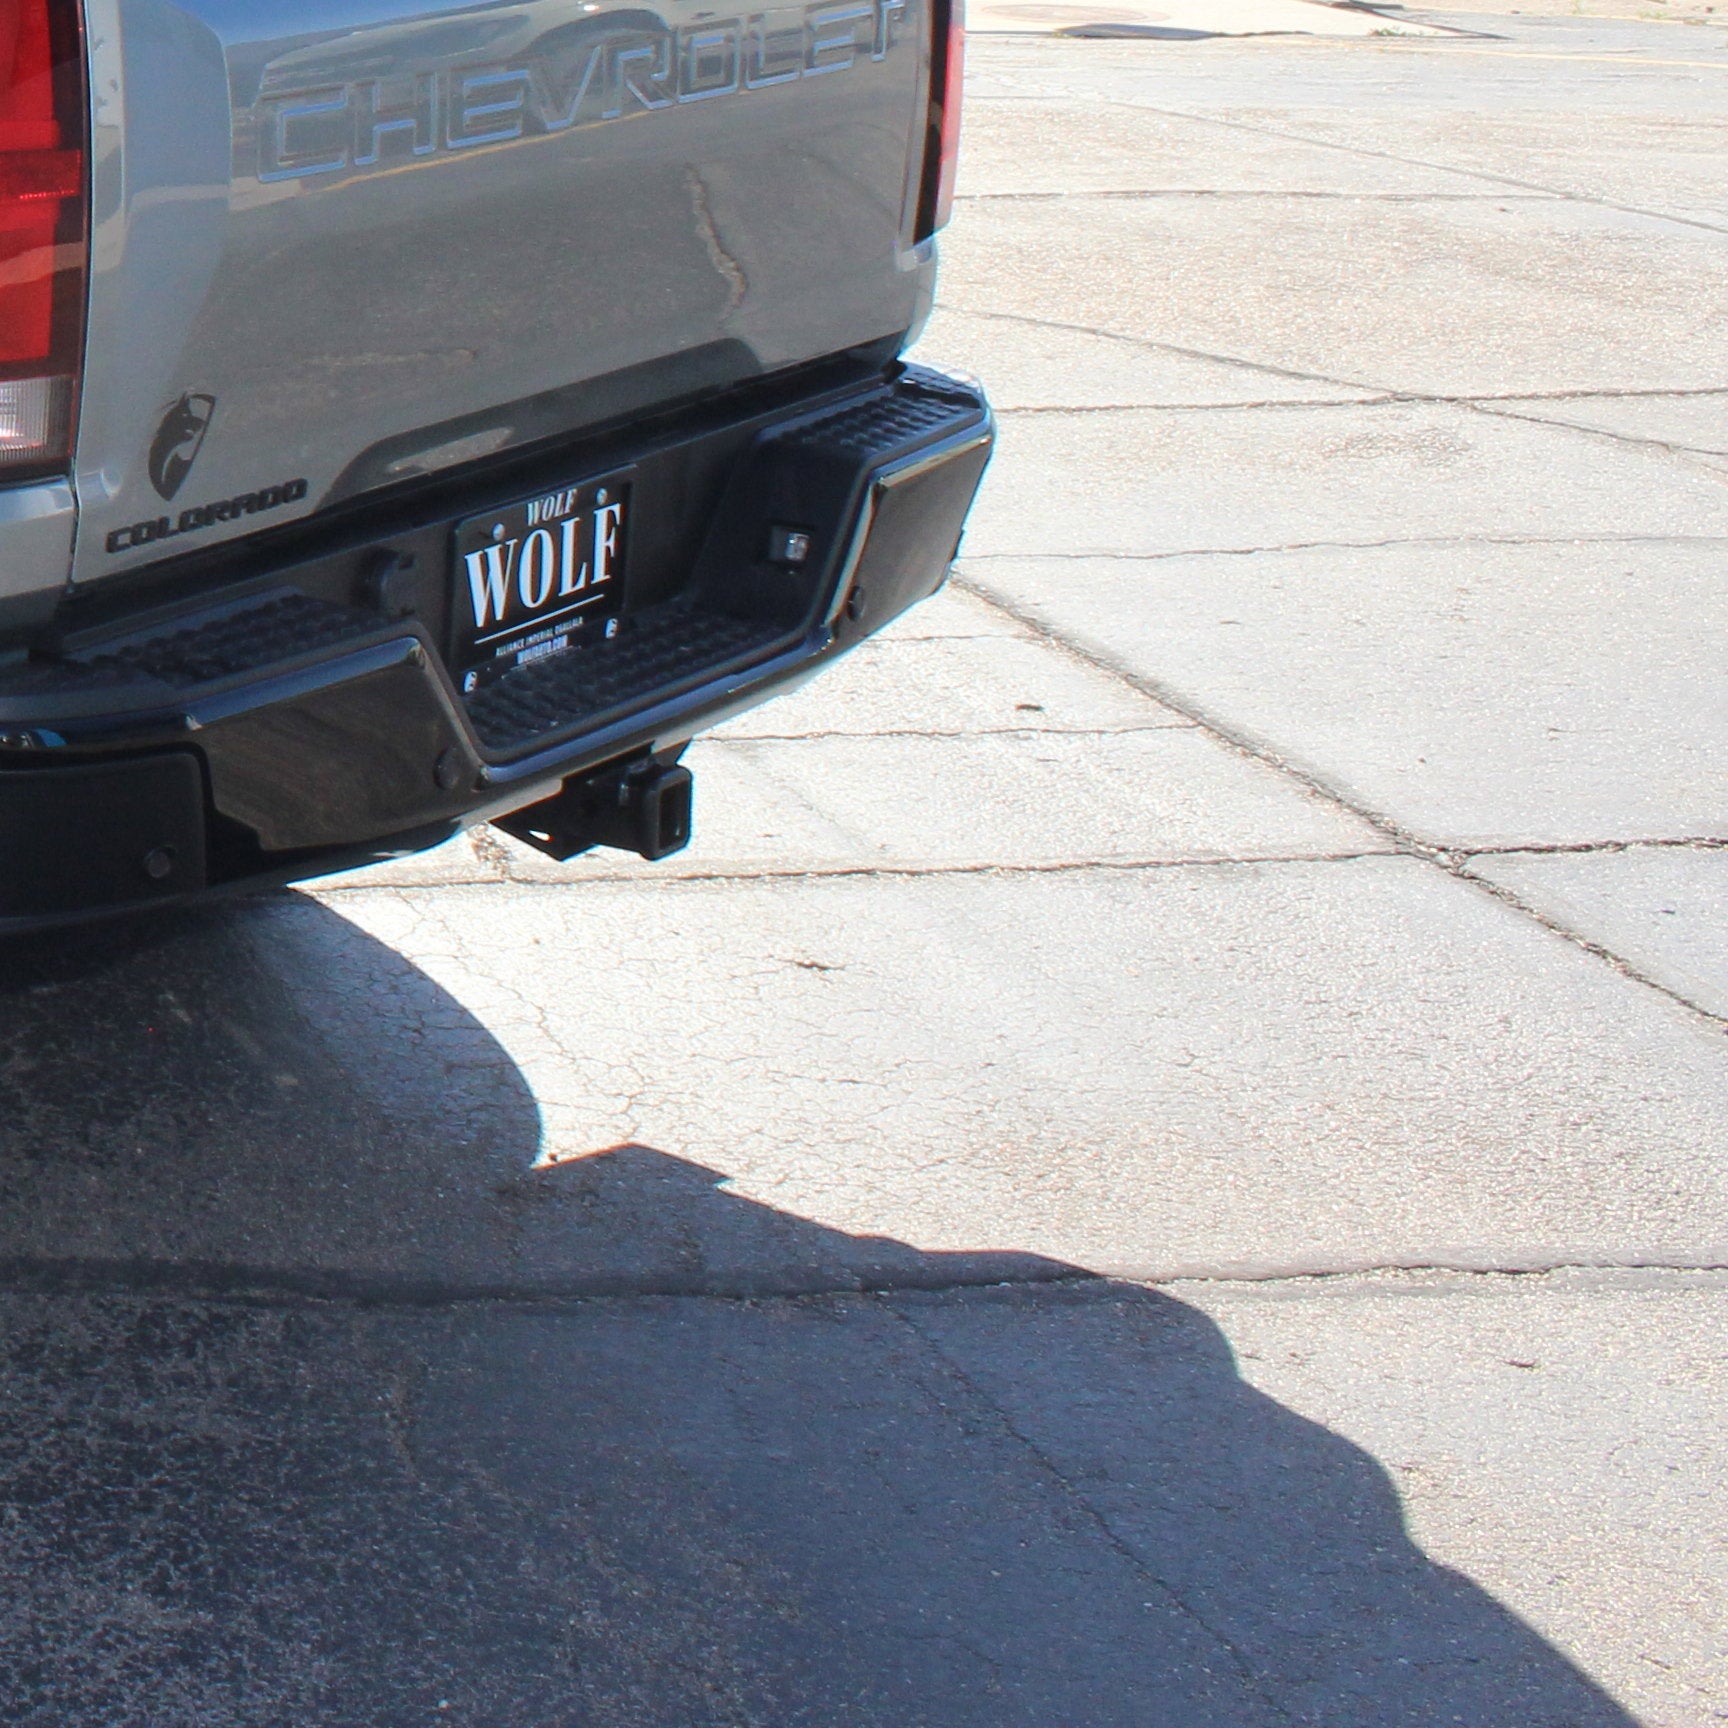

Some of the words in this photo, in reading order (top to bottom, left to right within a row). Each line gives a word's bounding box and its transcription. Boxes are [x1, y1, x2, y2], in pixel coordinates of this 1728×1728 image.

[105, 478, 308, 553] COLORADO
[527, 488, 578, 527] WOLF
[464, 503, 622, 628] WOLF
